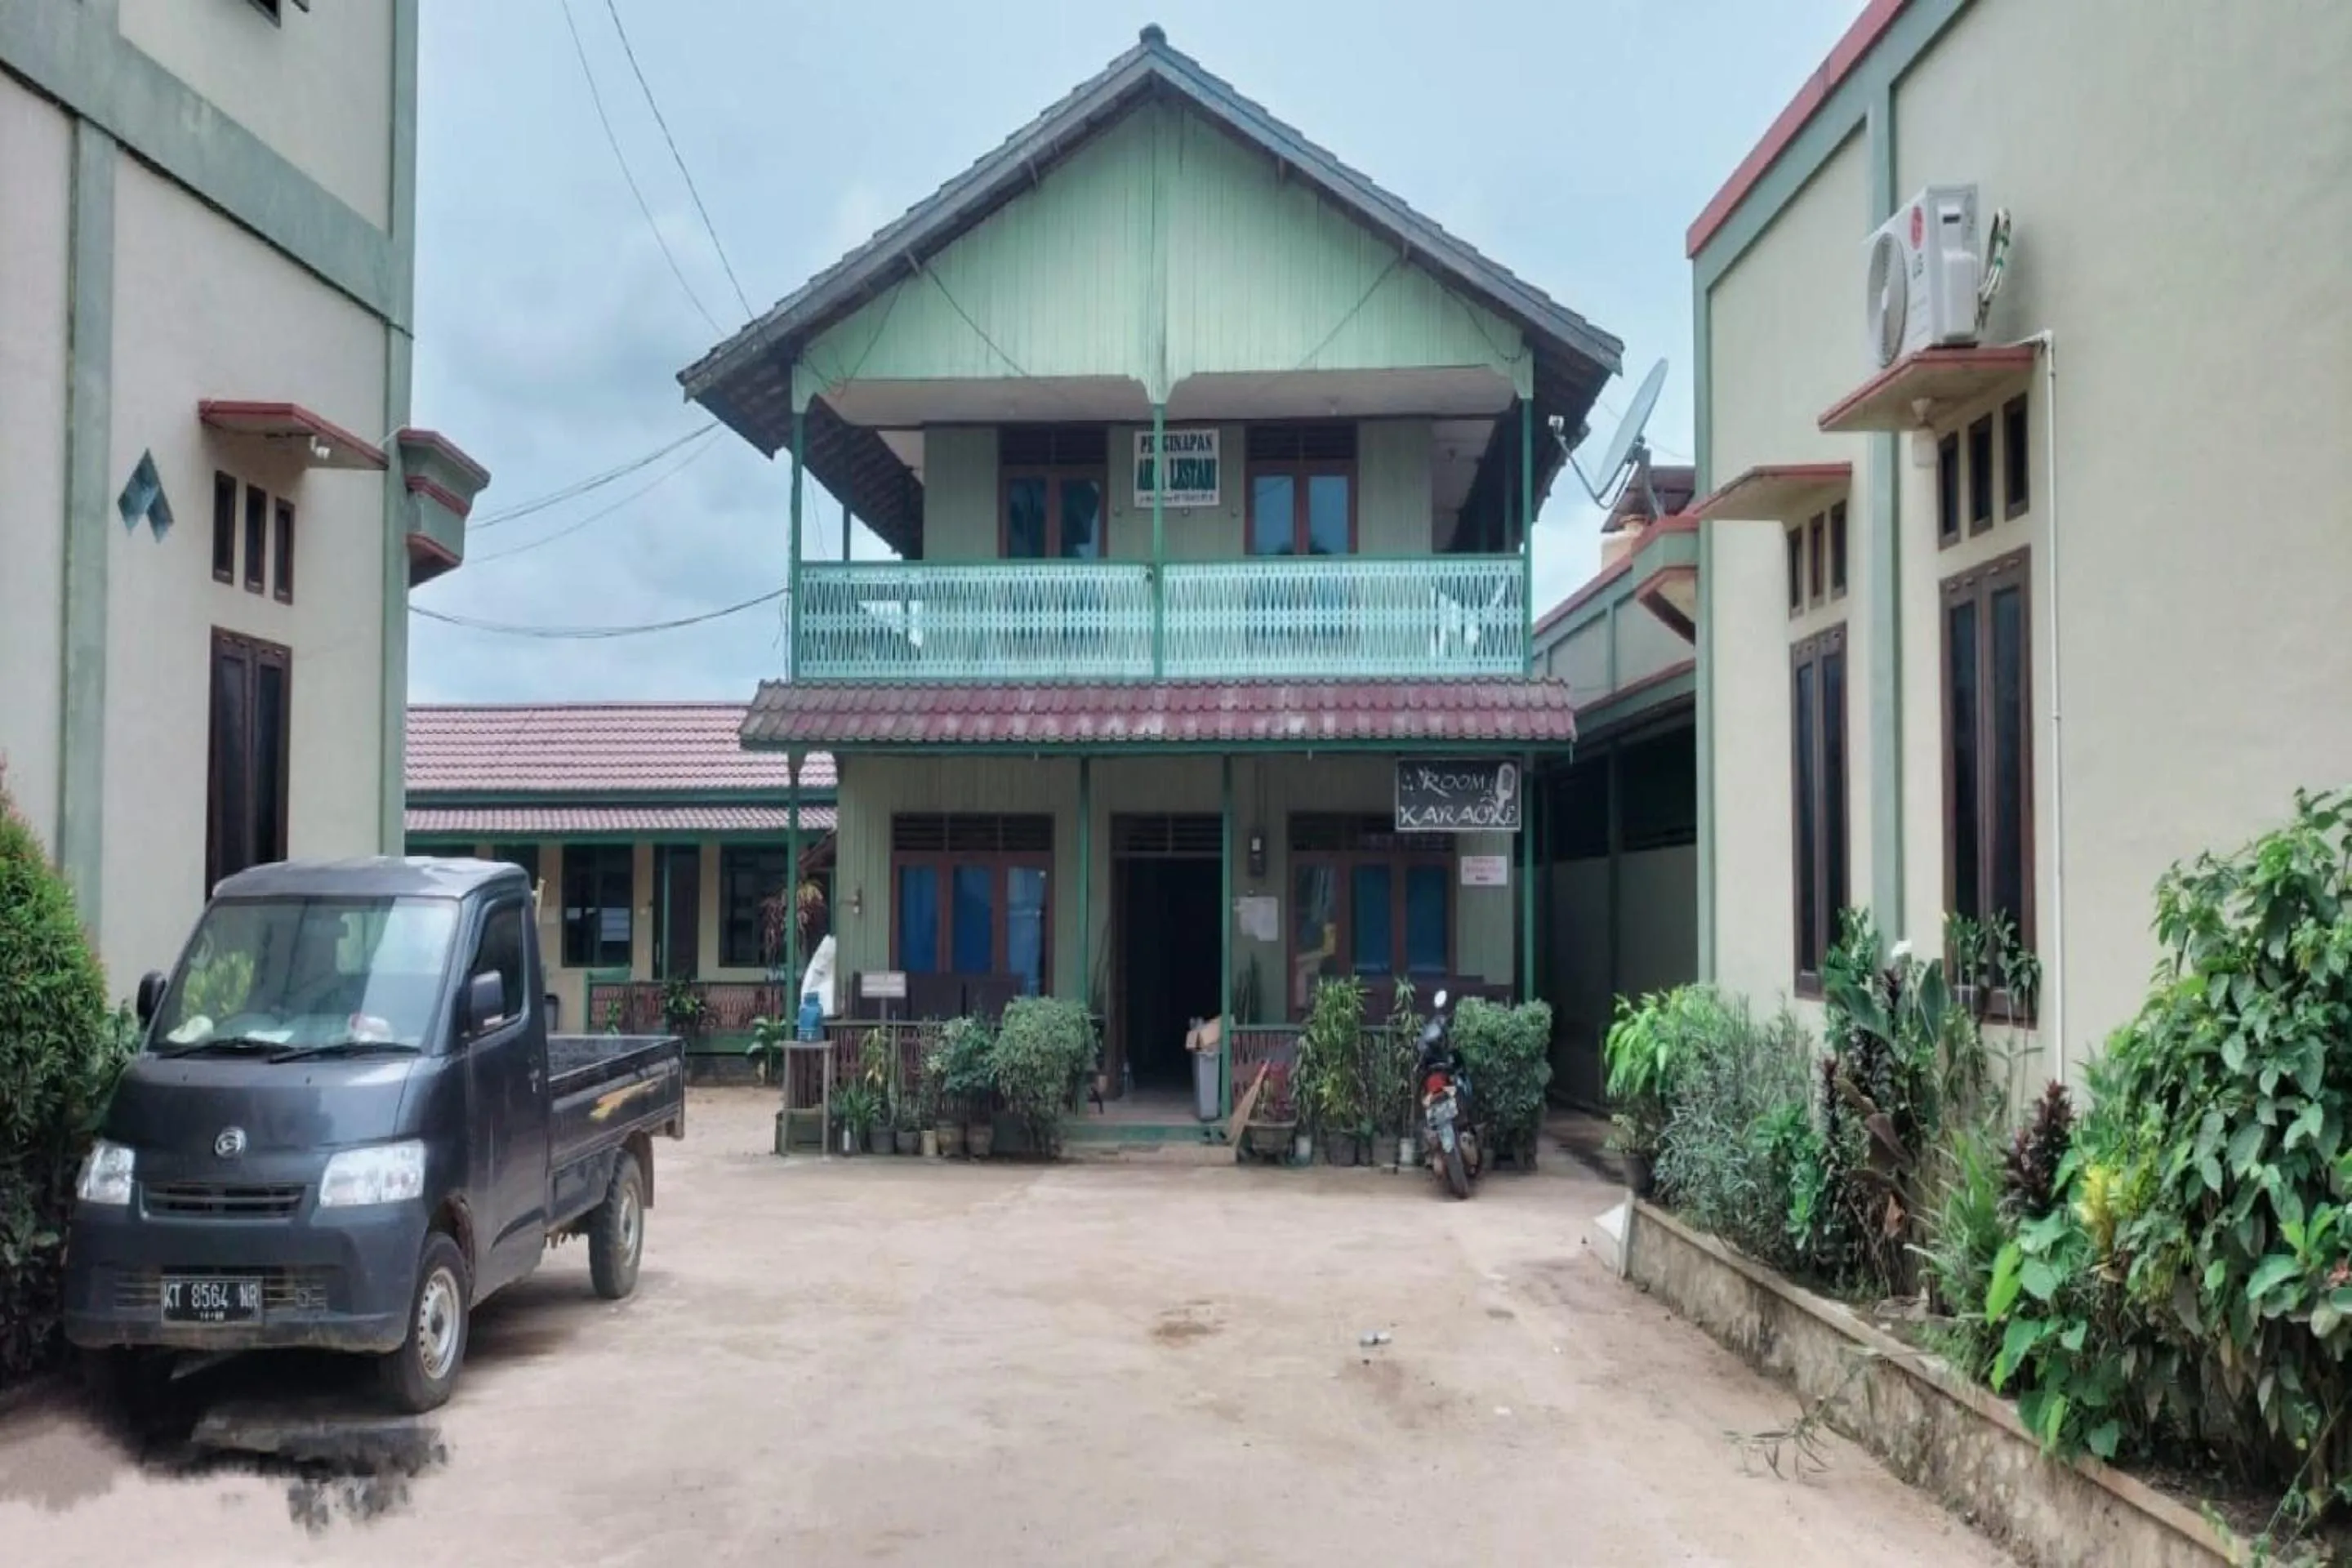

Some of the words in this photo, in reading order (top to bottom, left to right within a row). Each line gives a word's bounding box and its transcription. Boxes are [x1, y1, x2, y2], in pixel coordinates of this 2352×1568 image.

[1141, 434, 1213, 453] PEGINAPAN
[1419, 767, 1485, 798] ROOM
[1400, 804, 1516, 825] KARAOKE
[164, 1283, 181, 1308] KT
[191, 1283, 228, 1307] 8564
